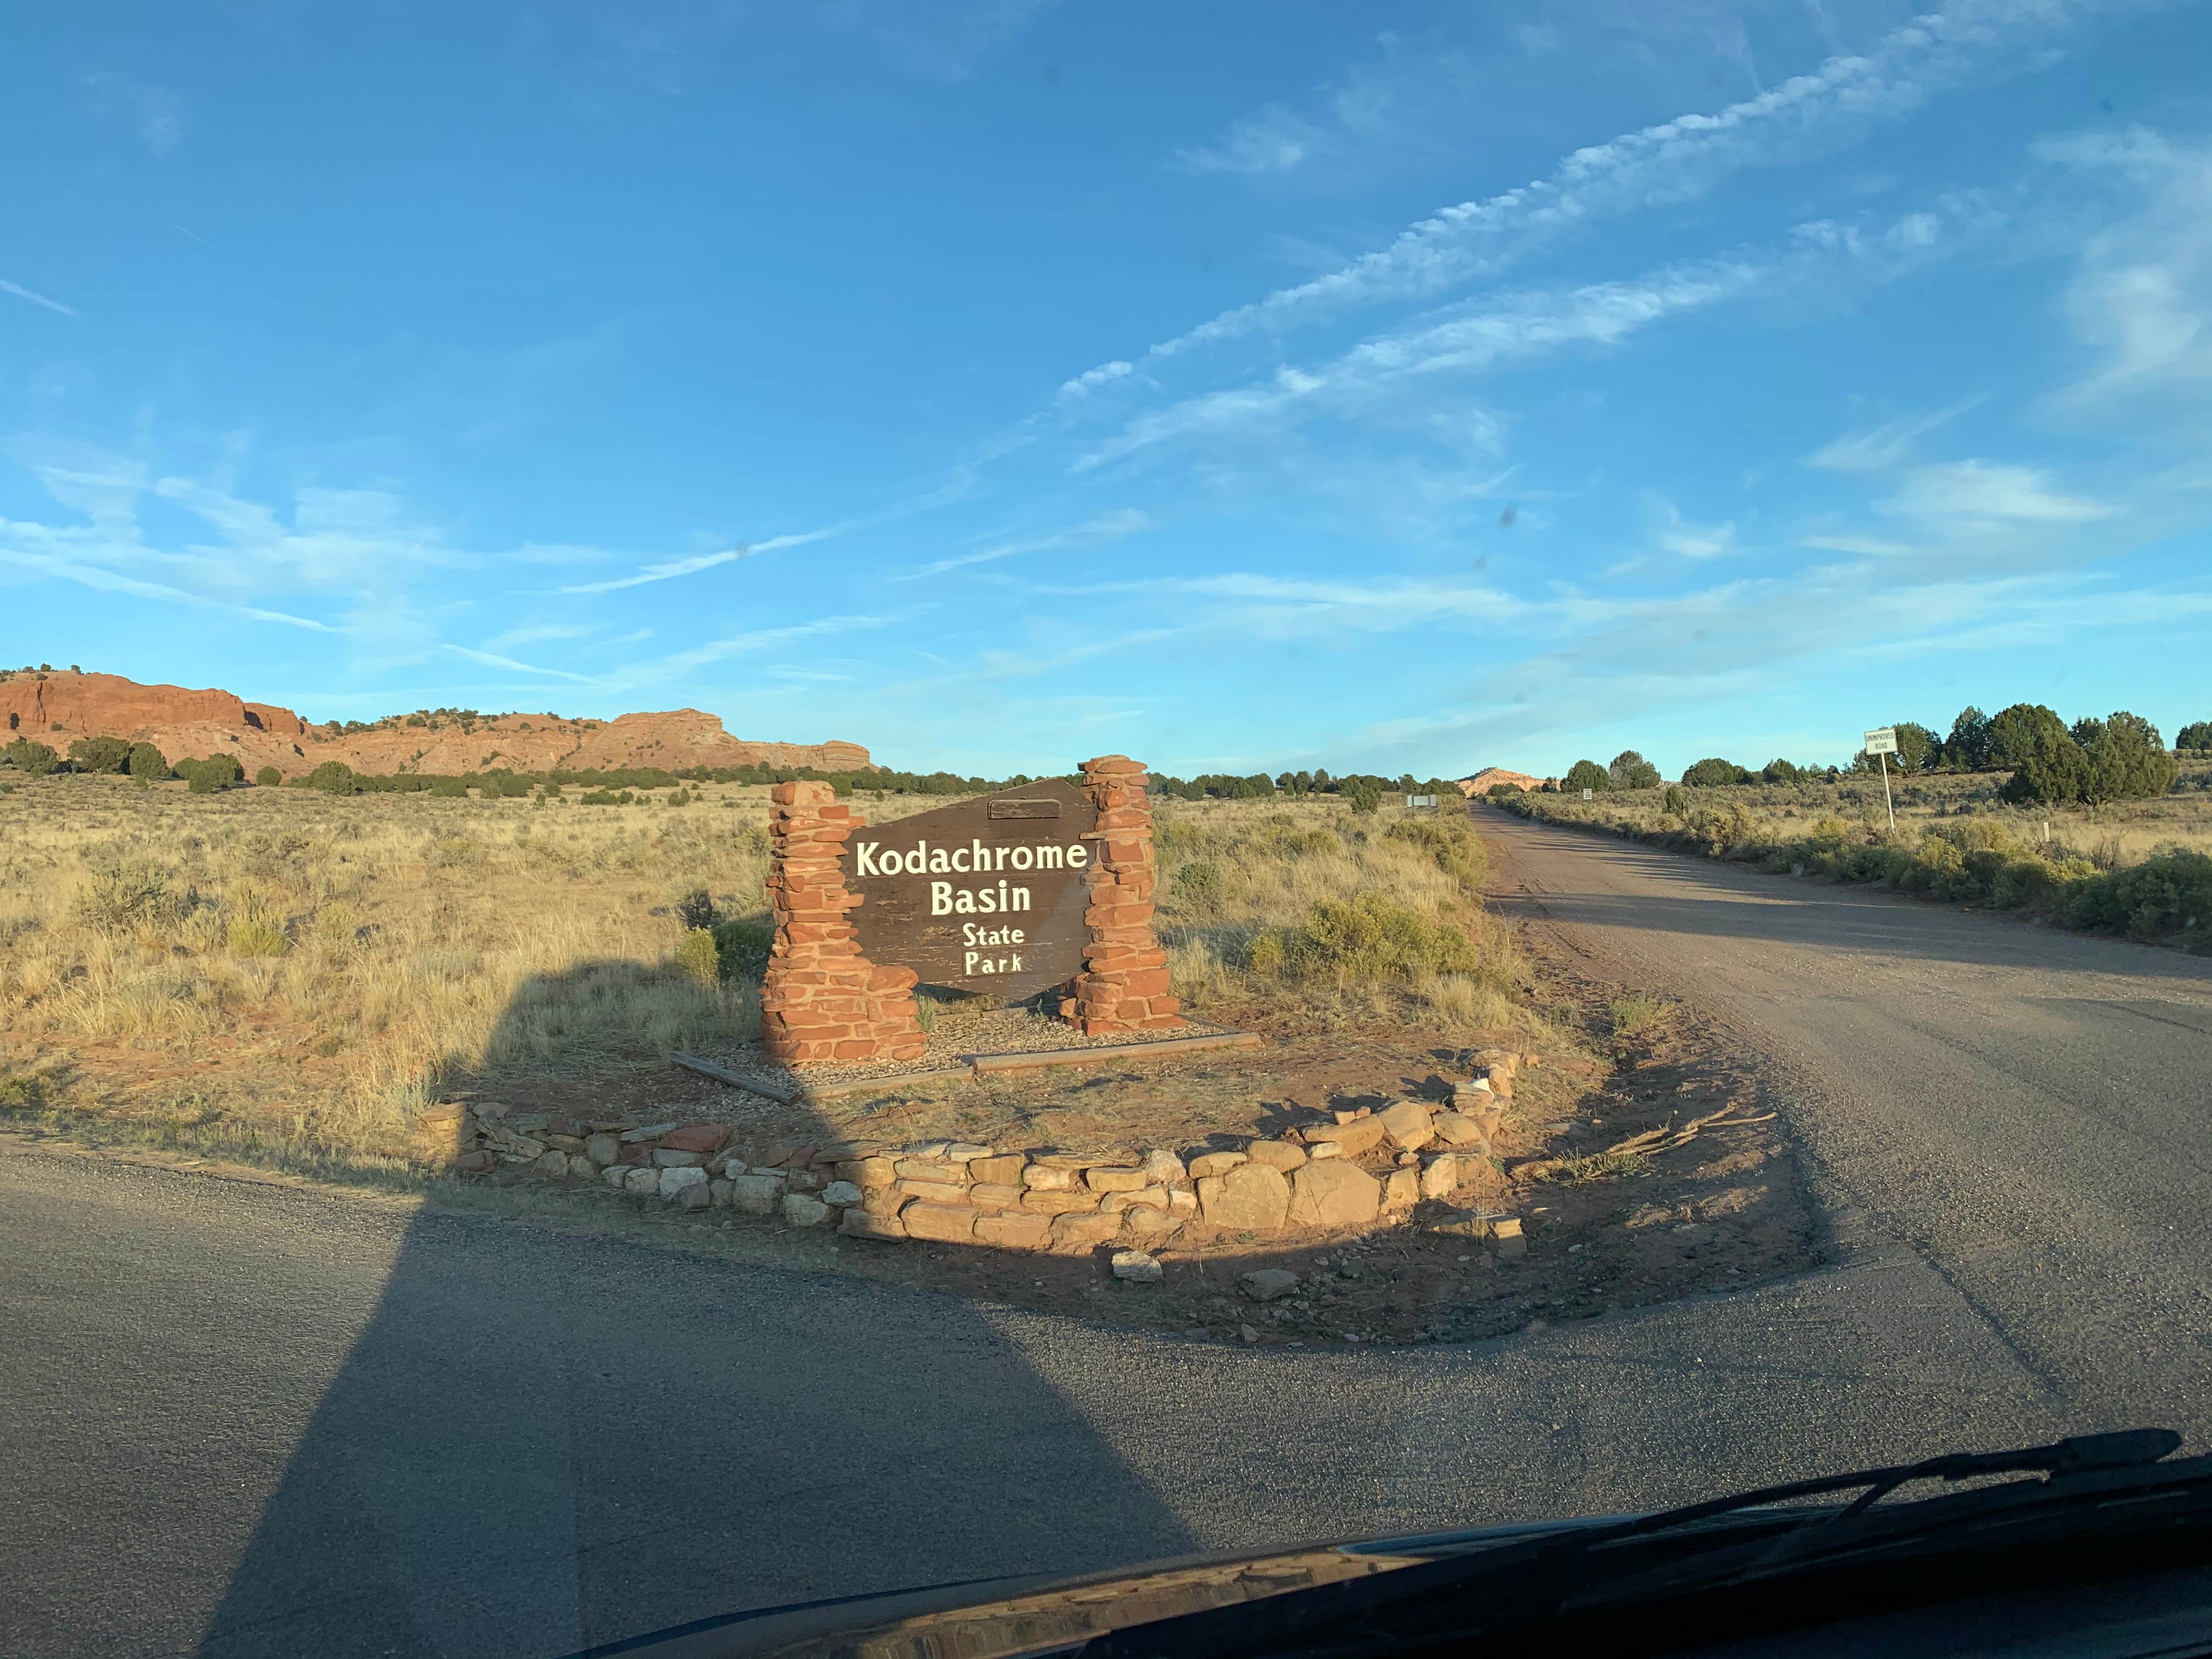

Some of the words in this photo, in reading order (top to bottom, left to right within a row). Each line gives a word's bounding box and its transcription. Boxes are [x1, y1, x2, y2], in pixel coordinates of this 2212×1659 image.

[1866, 733, 1893, 742] UNIMPROVED
[856, 839, 1087, 876] Kodachrome
[931, 879, 1030, 916] Basin
[963, 922, 1024, 947] State
[965, 951, 1022, 975] Park
